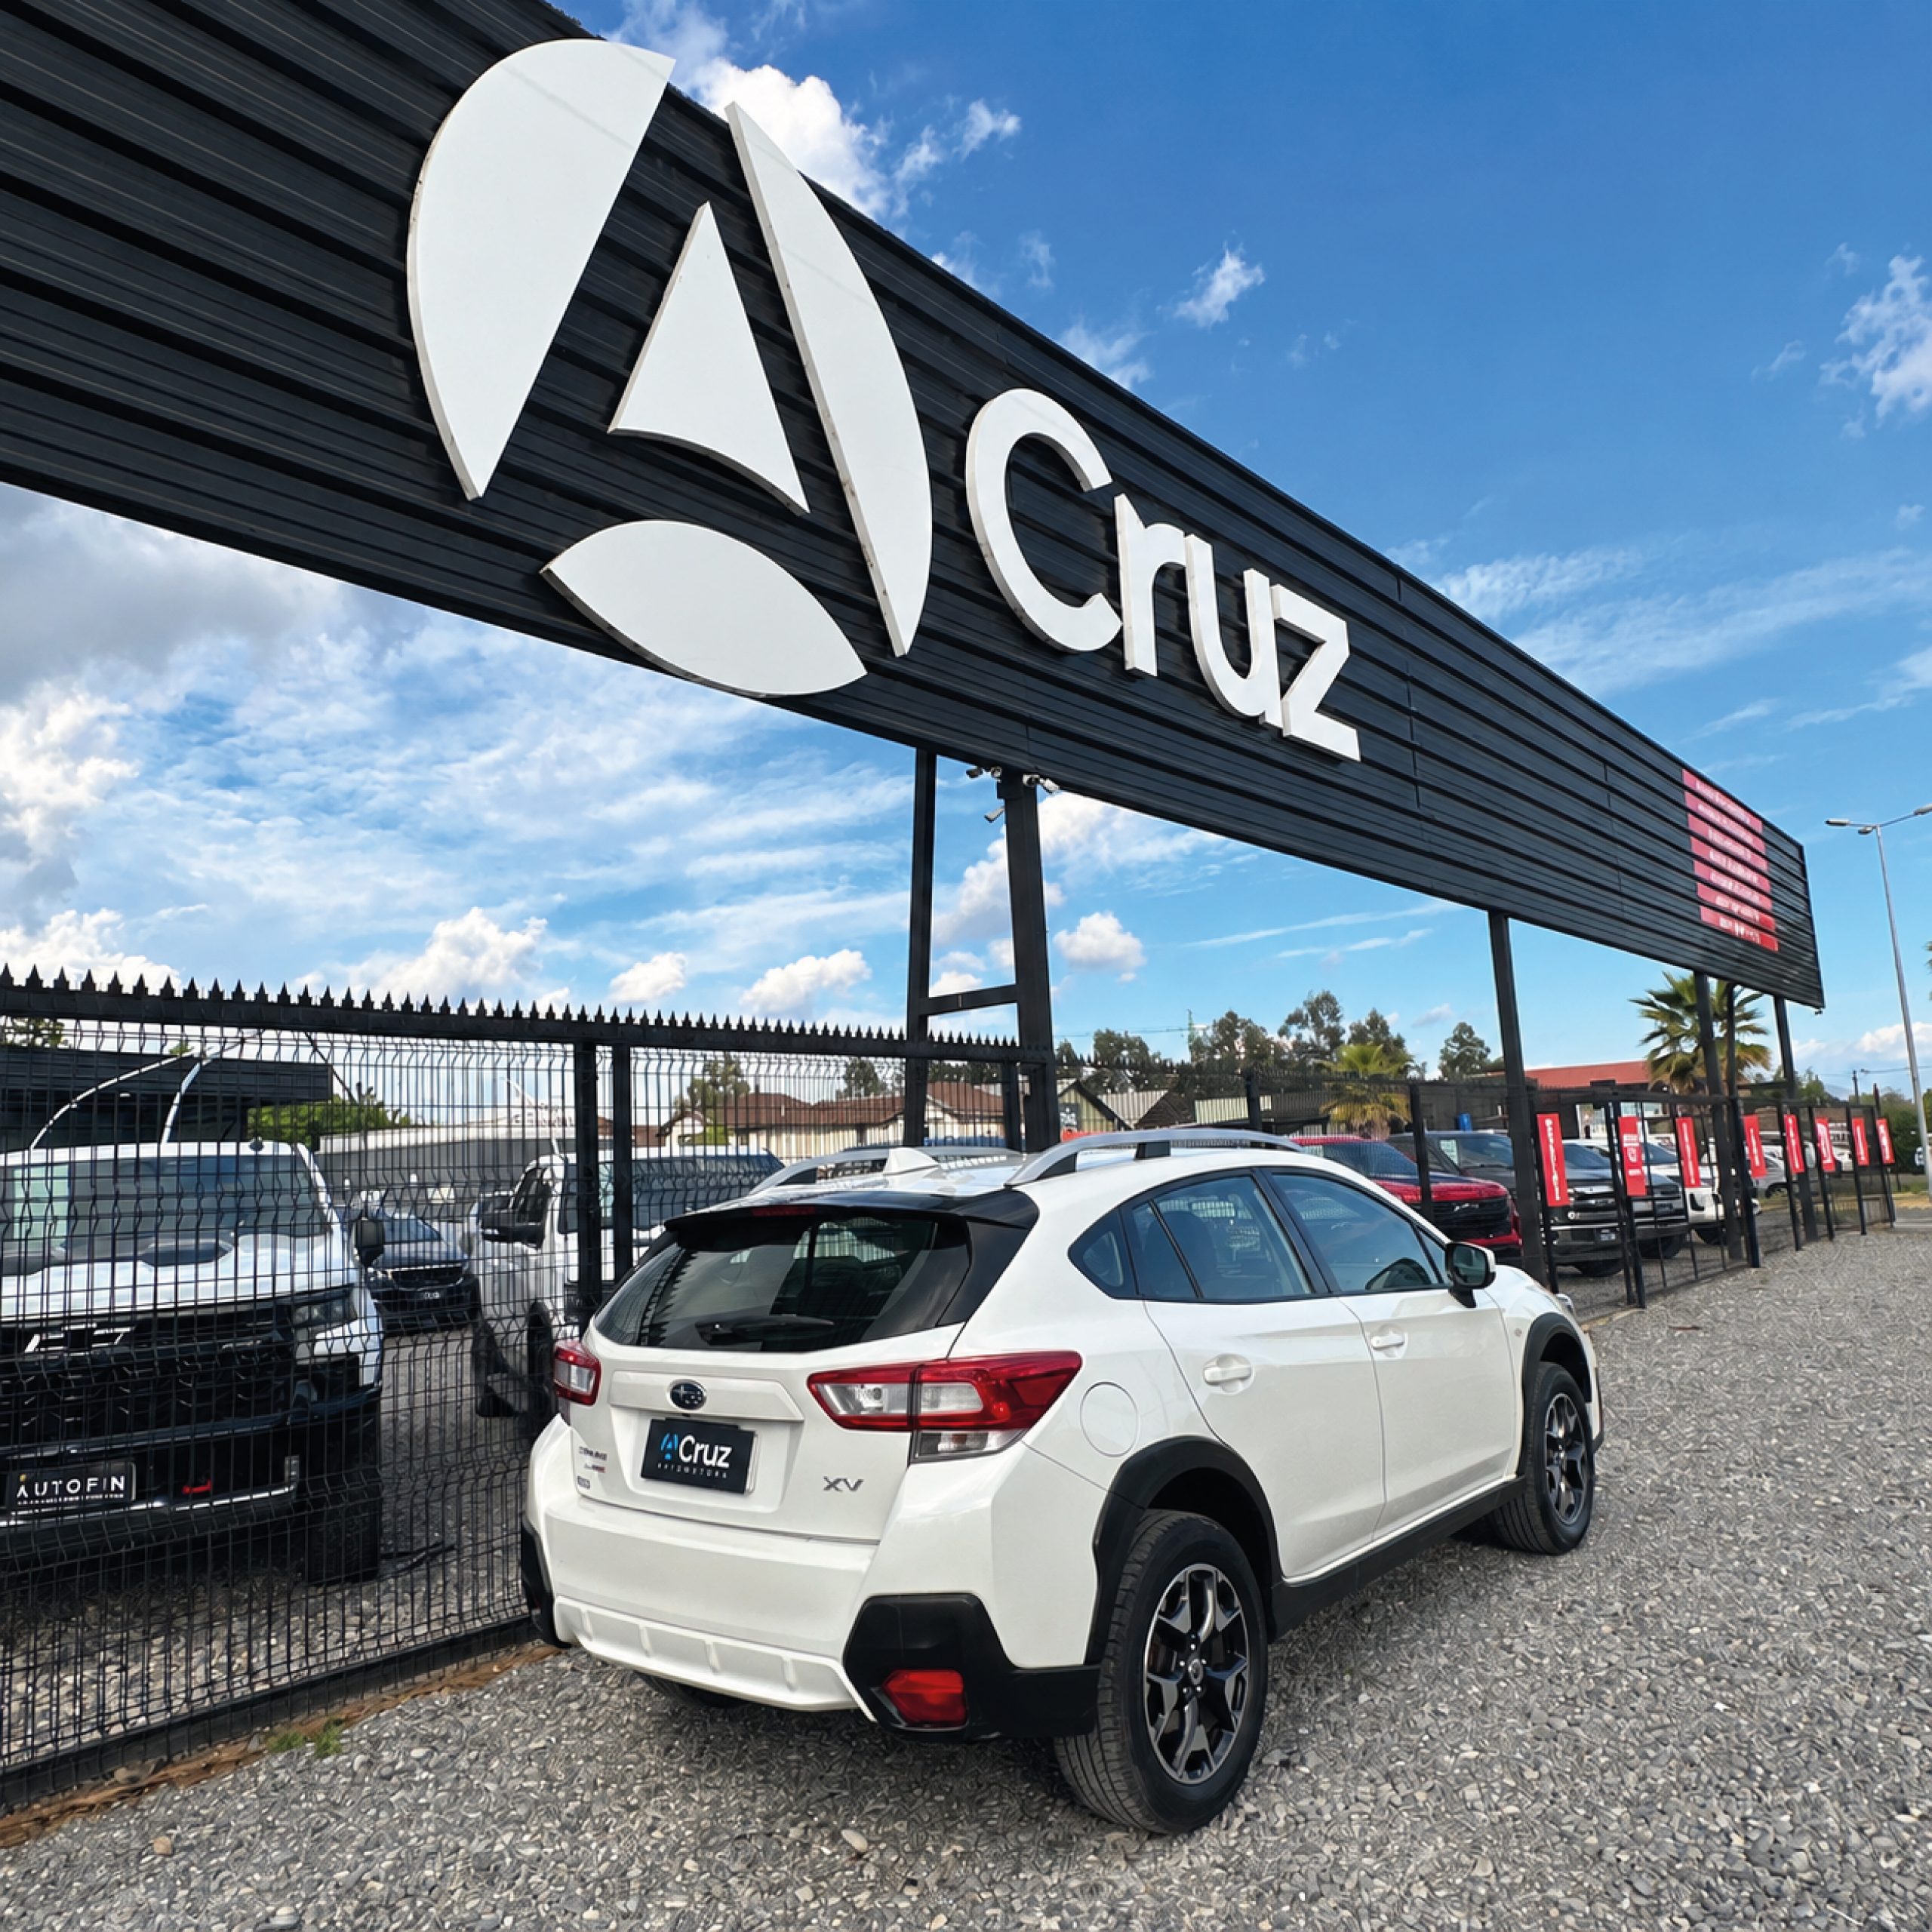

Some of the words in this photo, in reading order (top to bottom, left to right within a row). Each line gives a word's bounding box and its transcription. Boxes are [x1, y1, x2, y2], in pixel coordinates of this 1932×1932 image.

[965, 388, 1361, 762] Cruz
[680, 1435, 732, 1469] Cruz
[17, 1475, 126, 1499] AUTOFIN
[823, 1476, 863, 1492] XV
